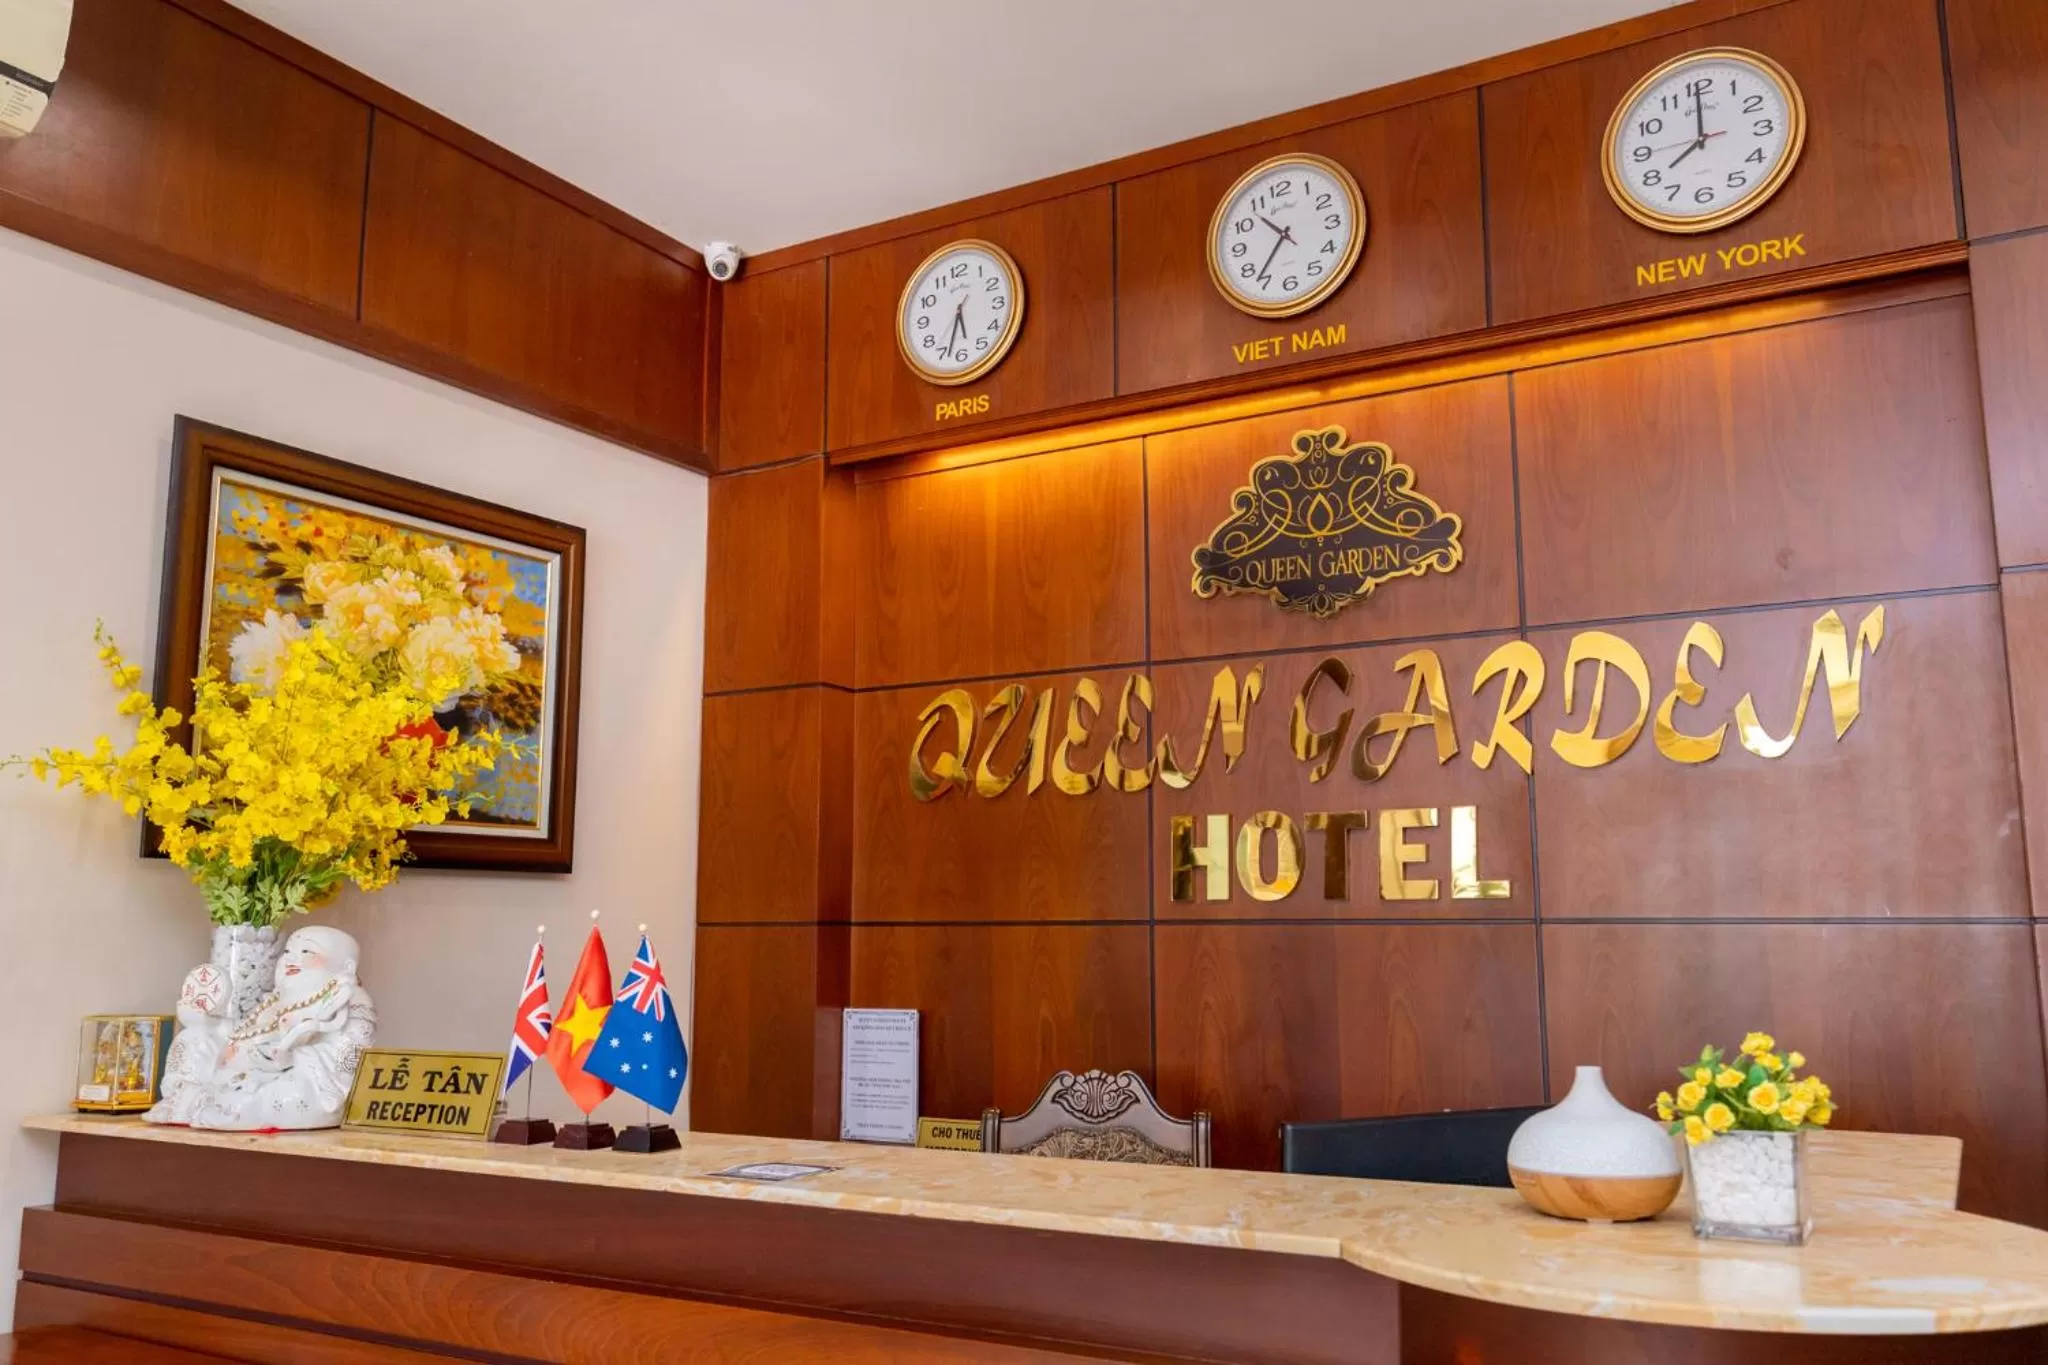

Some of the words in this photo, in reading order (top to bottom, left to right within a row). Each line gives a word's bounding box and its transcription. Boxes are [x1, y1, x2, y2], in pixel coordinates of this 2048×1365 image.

[1685, 78, 1713, 98] 12
[1729, 79, 1737, 97] 1
[1660, 94, 1679, 112] 11
[1742, 95, 1764, 115] 2
[1638, 118, 1663, 137] 10
[1752, 119, 1774, 137] 3
[1632, 145, 1653, 163] 9
[1744, 147, 1767, 164] 4
[1642, 169, 1662, 187] 8
[1726, 170, 1747, 188] 5
[1269, 180, 1292, 199] 12
[1304, 181, 1310, 195] 1
[1664, 184, 1681, 201] 7
[1694, 186, 1715, 204] 6
[1251, 195, 1265, 212] 11
[1315, 193, 1332, 211] 2
[1234, 217, 1254, 235] 10
[1324, 214, 1341, 230] 3
[1232, 242, 1248, 258] 9
[1320, 239, 1336, 254] 4
[1307, 260, 1323, 276] 5
[1636, 253, 1707, 286] NEW
[1717, 233, 1806, 270] YORK
[950, 263, 968, 279] 12
[978, 265, 983, 278] 1
[1240, 263, 1256, 278] 8
[935, 276, 947, 290] 11
[985, 277, 999, 292] 2
[1260, 274, 1272, 290] 7
[1282, 276, 1298, 292] 6
[921, 294, 937, 309] 10
[992, 296, 1005, 310] 3
[917, 316, 930, 330] 9
[987, 318, 1000, 331] 4
[923, 335, 935, 348] 8
[975, 336, 988, 350] 5
[1232, 336, 1284, 363] VIET
[1292, 324, 1346, 352] NAM
[936, 346, 948, 360] 7
[955, 349, 968, 362] 6
[936, 394, 990, 421] PARIS
[1246, 554, 1311, 585] QUEEN
[1319, 545, 1400, 579] GARDEN
[909, 663, 1264, 800] QUEEN
[1290, 604, 1886, 783] GARDEN
[1170, 805, 1511, 902] HOTEL
[422, 1065, 489, 1095] TÂN
[367, 1101, 470, 1126] RECEPTION
[932, 1126, 952, 1138] CHO
